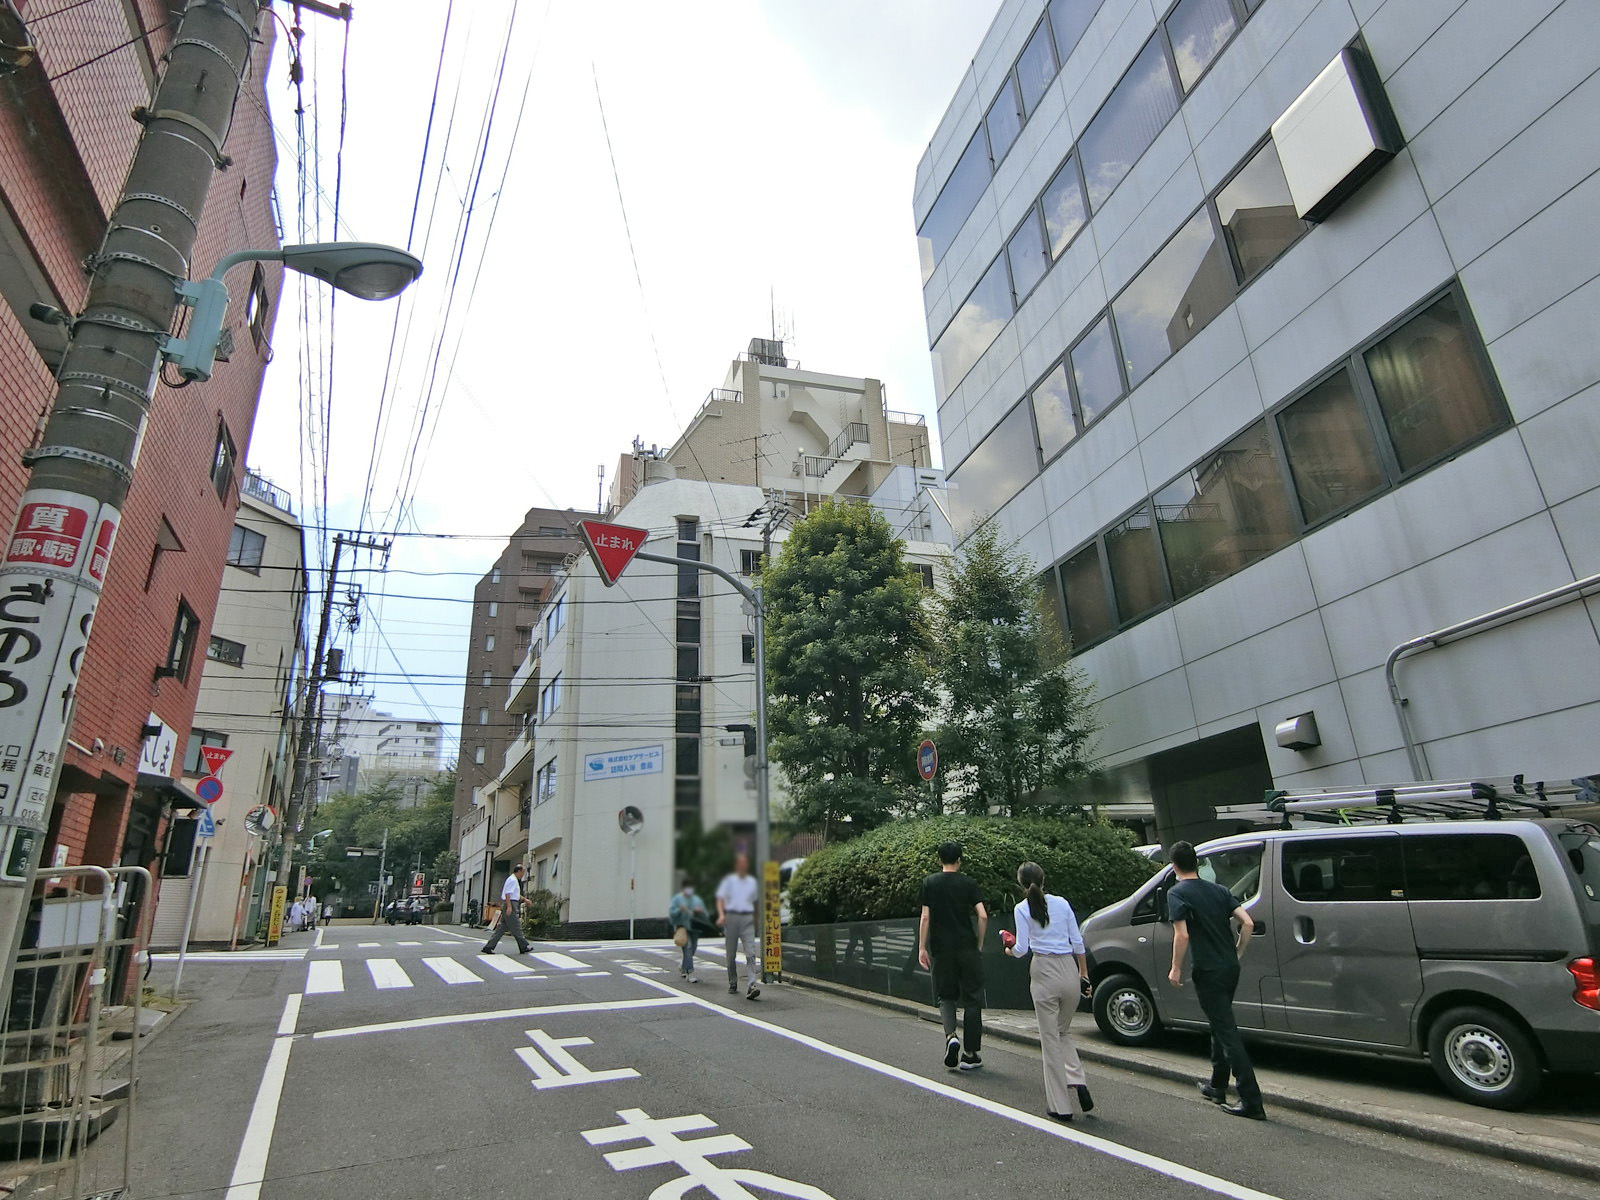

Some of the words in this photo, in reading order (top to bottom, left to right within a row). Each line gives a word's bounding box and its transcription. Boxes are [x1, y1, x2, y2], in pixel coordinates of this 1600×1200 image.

[28, 506, 69, 532] 質
[9, 538, 76, 561] 買取・販売
[595, 533, 635, 550] 止まれ
[207, 751, 226, 761] 止まれ
